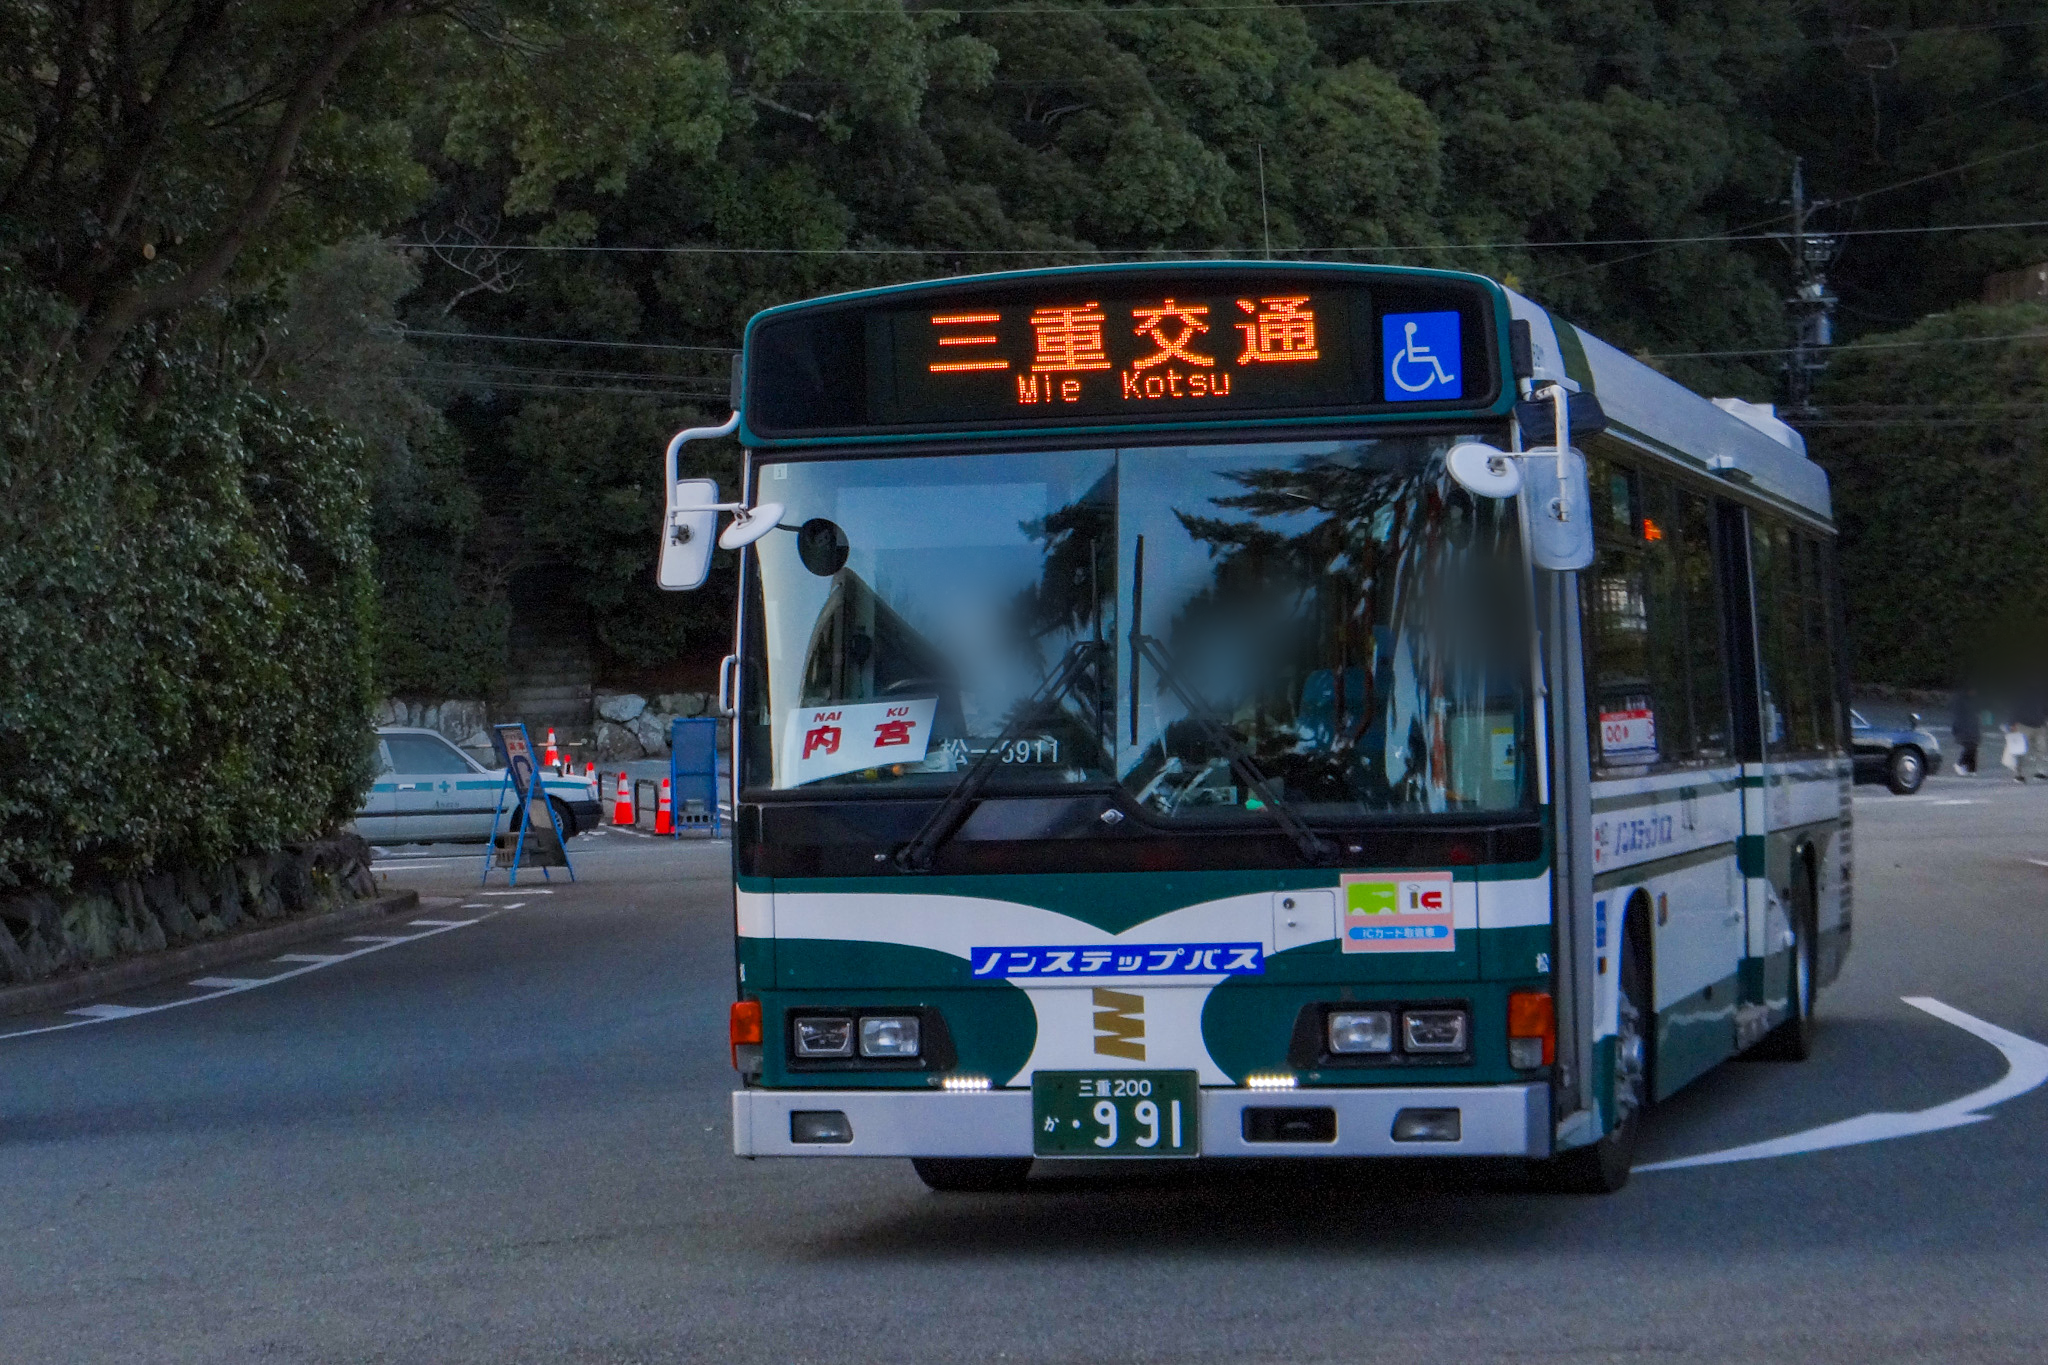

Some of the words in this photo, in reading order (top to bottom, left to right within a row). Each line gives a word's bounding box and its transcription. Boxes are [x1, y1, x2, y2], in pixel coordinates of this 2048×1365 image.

[929, 296, 1319, 371] 三重交通
[1017, 374, 1081, 404] Mie
[1121, 370, 1232, 399] Kotsu
[813, 711, 843, 723] NAI
[886, 706, 910, 718] KU
[802, 719, 917, 760] 内宮
[974, 946, 1258, 976] ノンステップバス
[1078, 1079, 1153, 1098] 三重200
